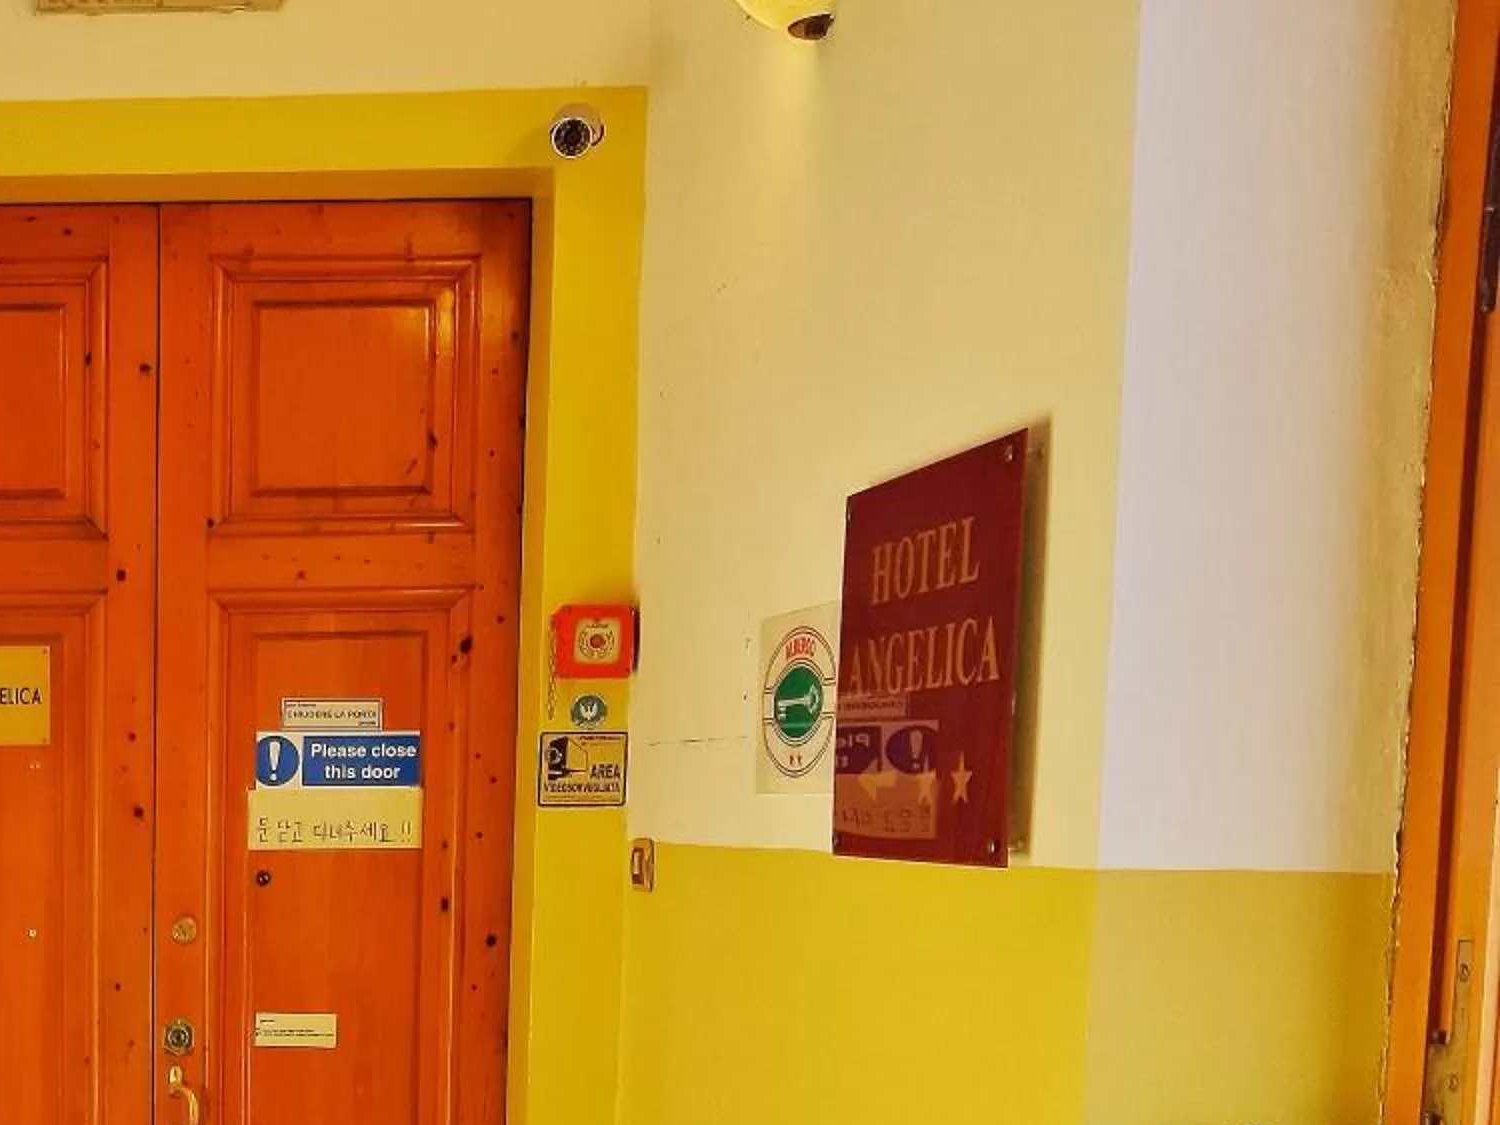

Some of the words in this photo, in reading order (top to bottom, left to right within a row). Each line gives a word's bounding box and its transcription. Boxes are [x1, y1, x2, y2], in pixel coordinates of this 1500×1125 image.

[871, 515, 980, 606] HOTEL
[849, 614, 1000, 698] ANGELICA
[311, 742, 367, 758] Please
[371, 742, 417, 757] close
[325, 764, 356, 779] this
[361, 764, 401, 779] door
[590, 764, 620, 779] AREA
